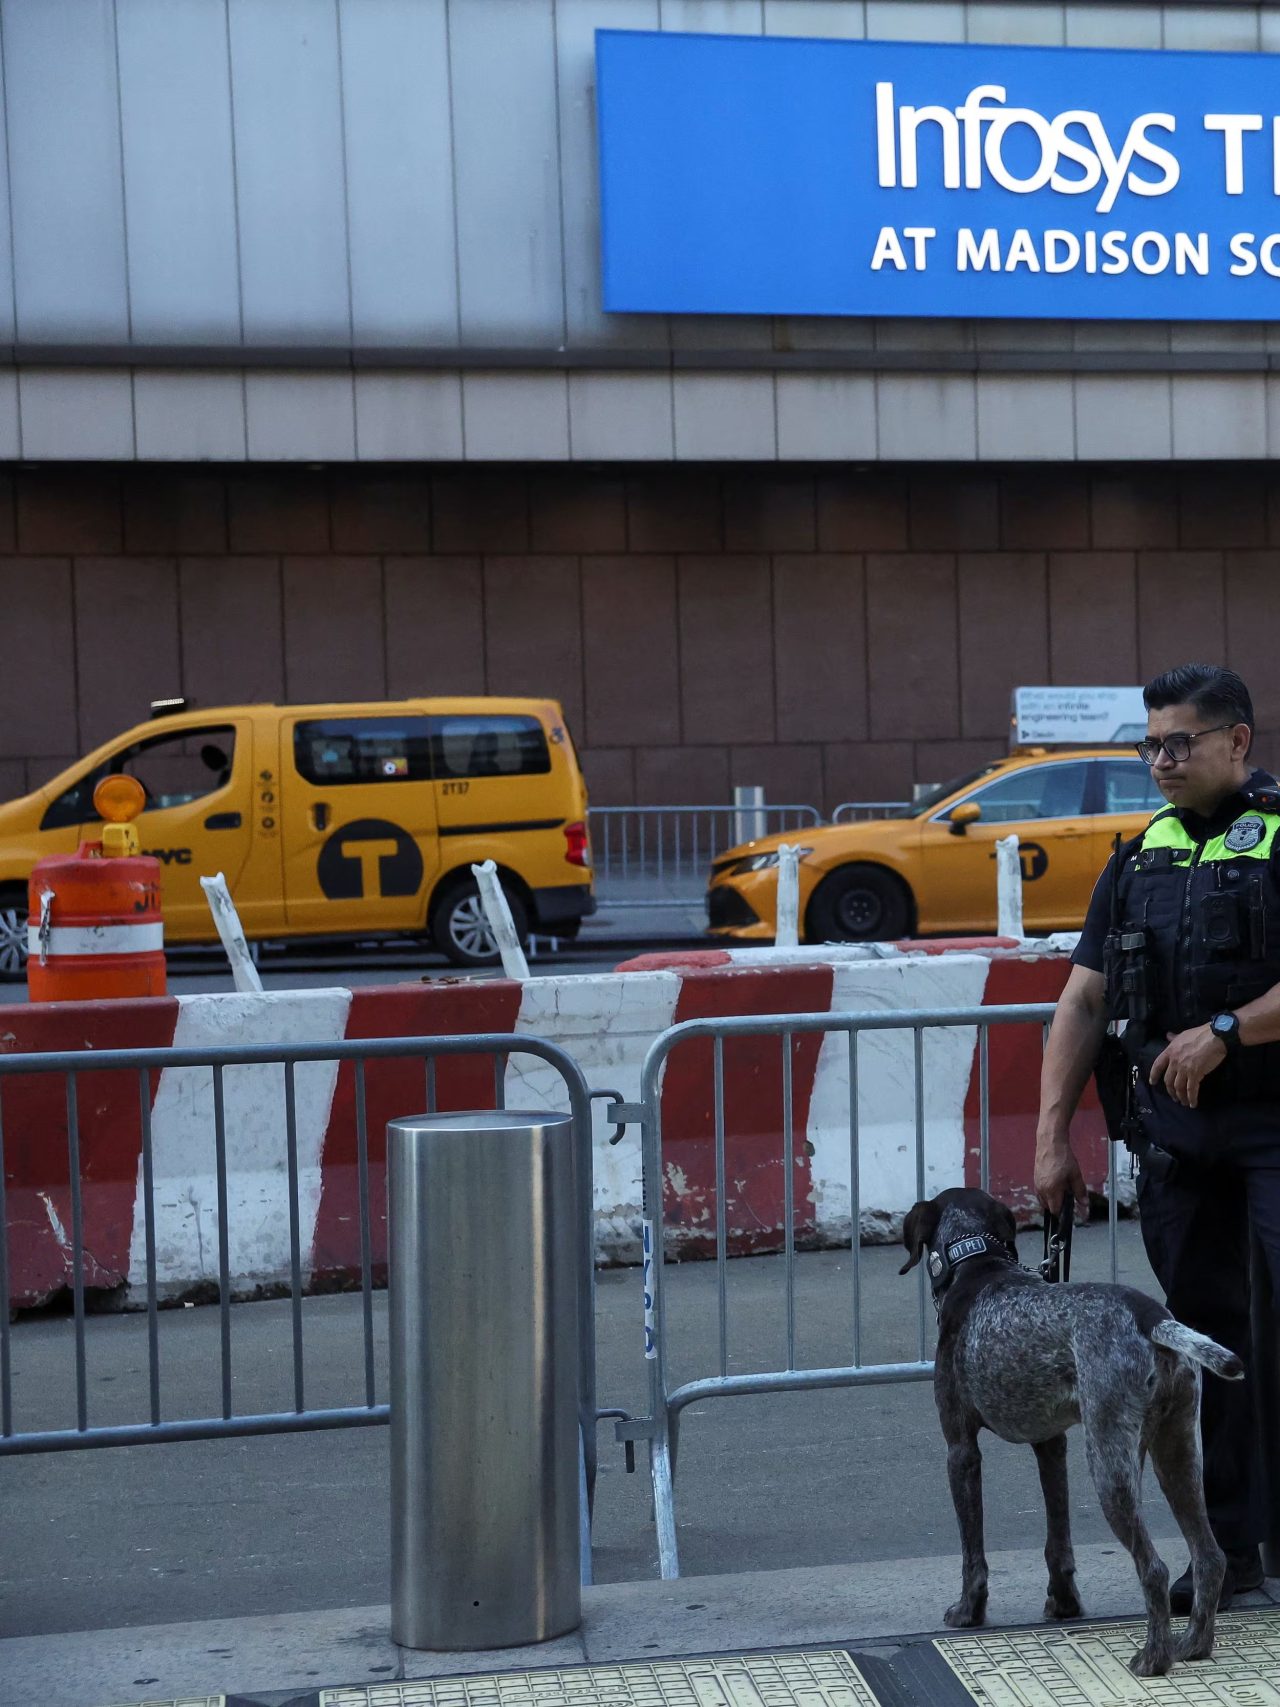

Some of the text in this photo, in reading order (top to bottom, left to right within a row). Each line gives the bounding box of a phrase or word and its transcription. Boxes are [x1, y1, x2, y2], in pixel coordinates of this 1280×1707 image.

[877, 82, 1180, 213] Infosys
[871, 227, 936, 270] AT
[957, 228, 1209, 275] MADISON
[964, 1239, 982, 1252] PET
